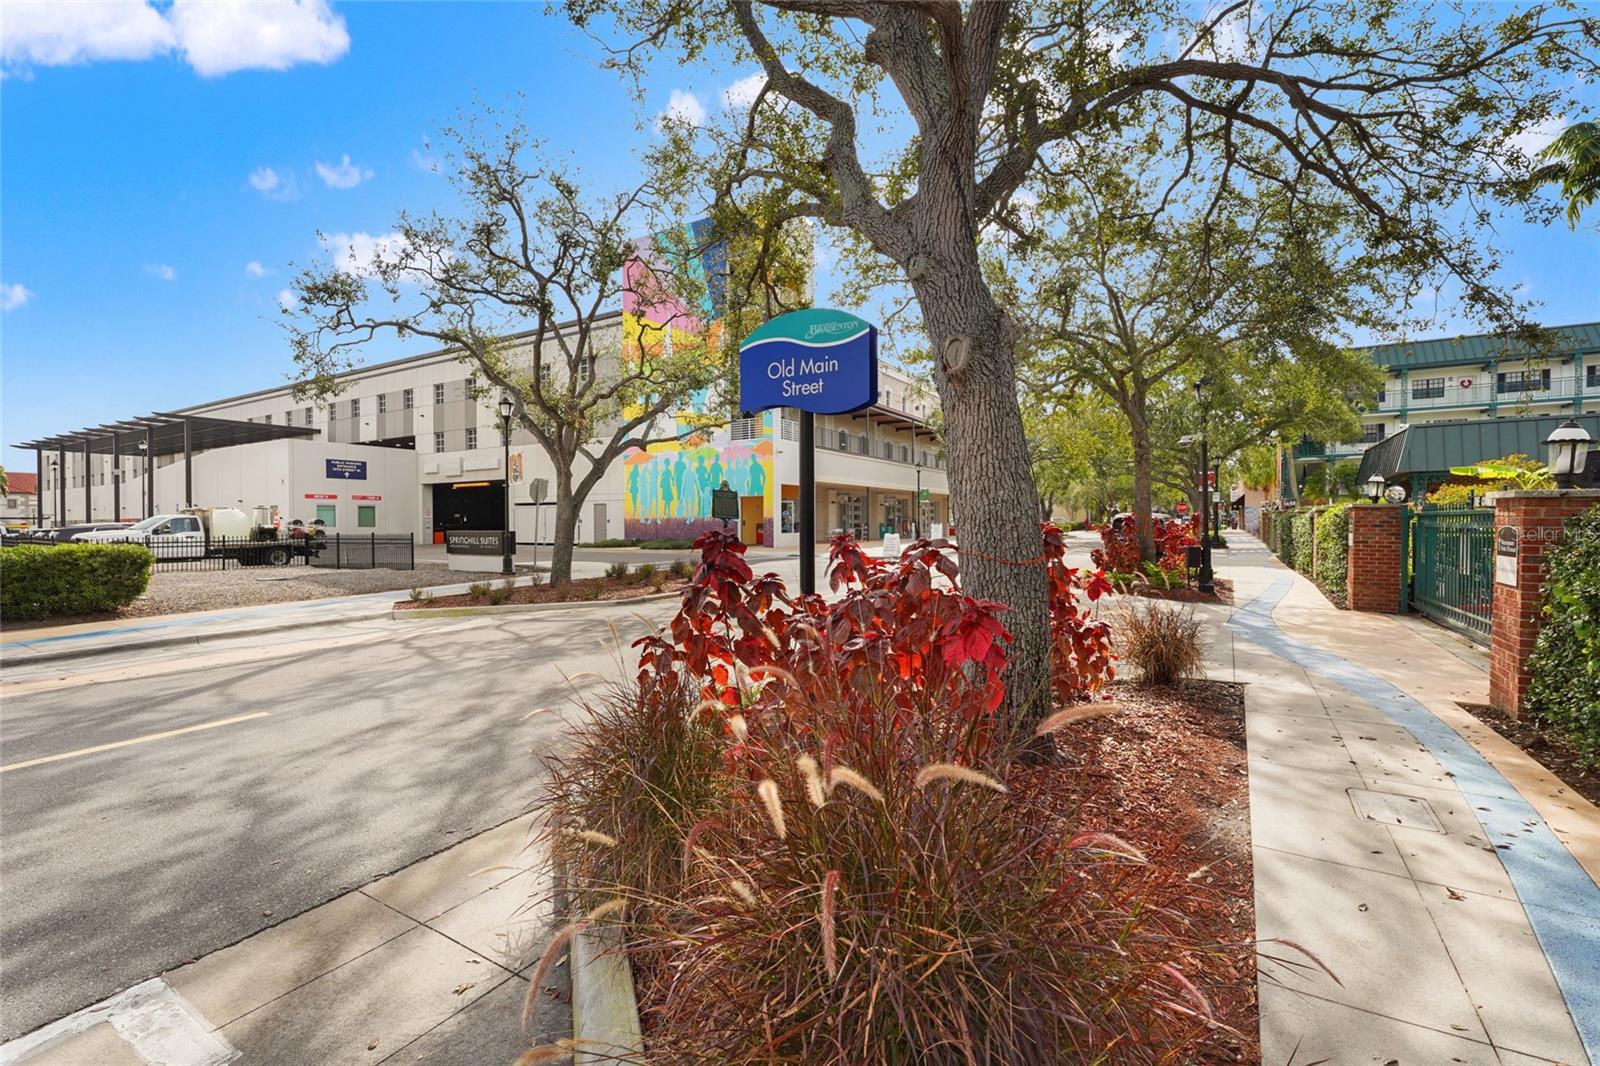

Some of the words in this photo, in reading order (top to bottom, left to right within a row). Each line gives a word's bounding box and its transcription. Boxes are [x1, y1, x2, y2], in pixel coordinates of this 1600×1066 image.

[767, 358, 795, 379] Old
[800, 355, 838, 376] Main
[782, 378, 824, 397] Street
[480, 536, 499, 545] SUITES
